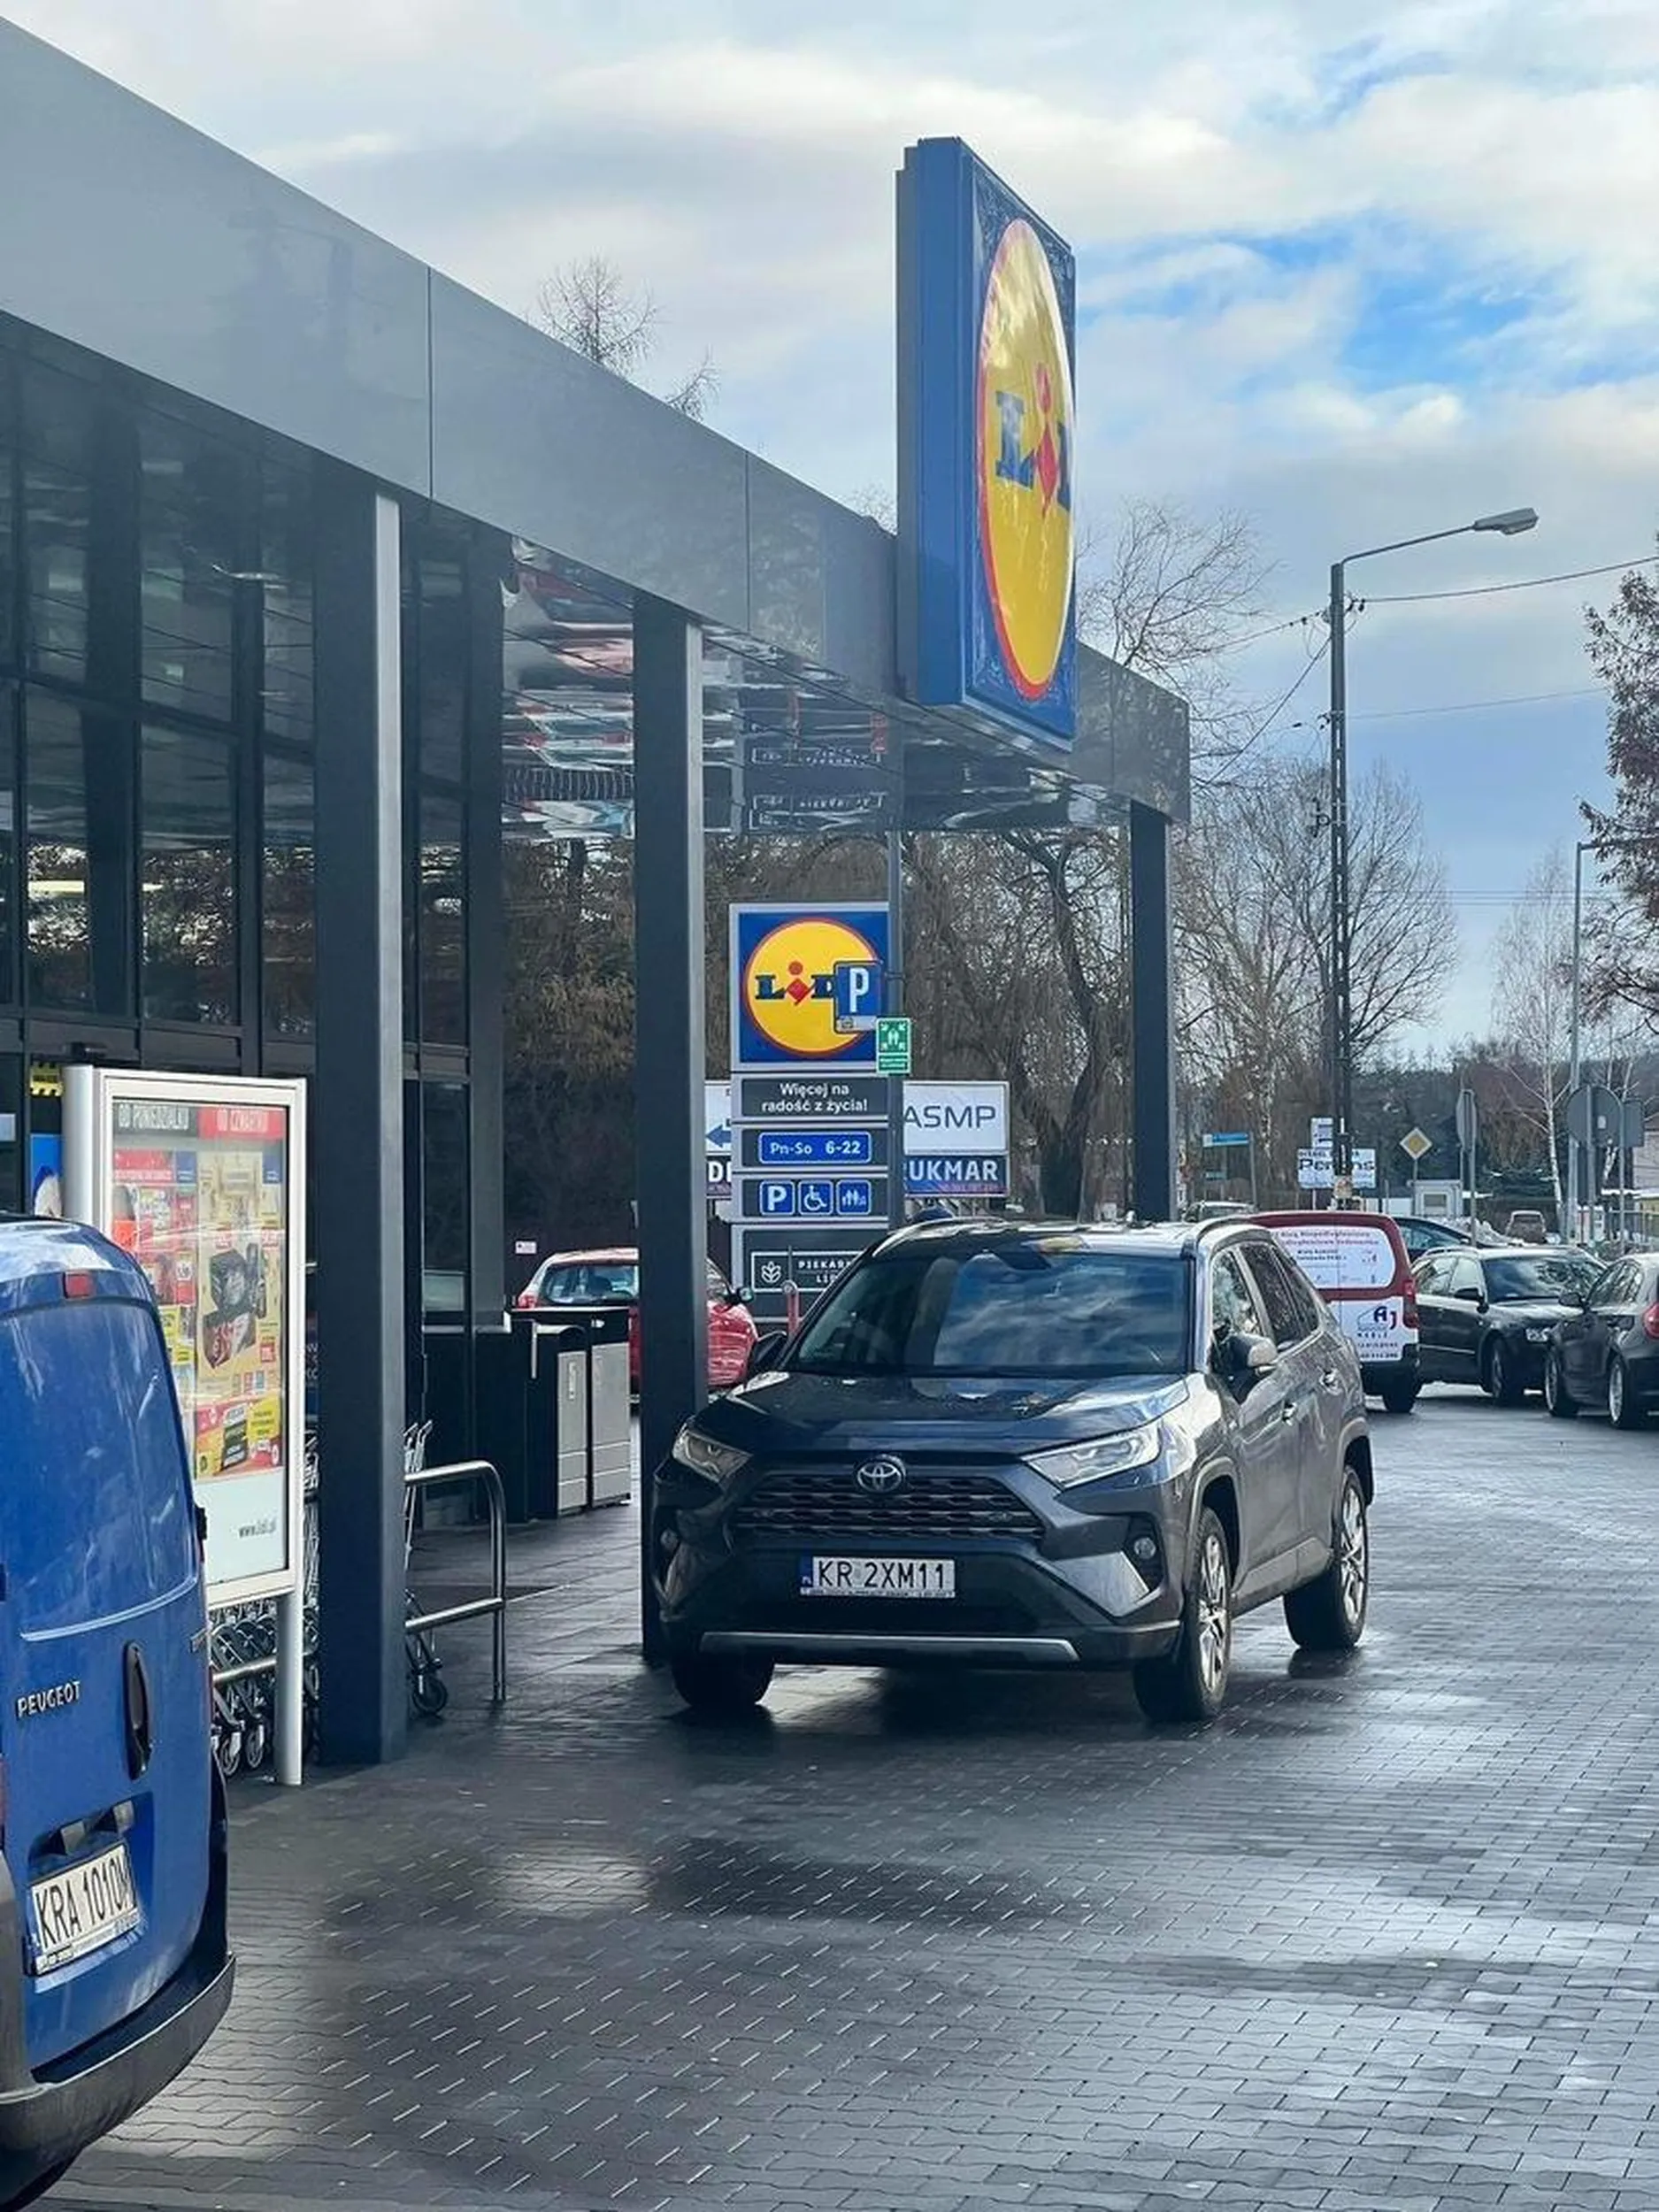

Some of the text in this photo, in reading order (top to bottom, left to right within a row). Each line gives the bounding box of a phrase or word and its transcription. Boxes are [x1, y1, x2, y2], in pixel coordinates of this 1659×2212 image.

[849, 967, 870, 1013] P
[780, 1083, 849, 1098] Więcej na
[762, 1099, 868, 1115] radość z życia!
[771, 1141, 861, 1155] Pn-So 6-22
[709, 1160, 998, 1183] D UKMAR
[767, 1185, 787, 1211] P
[818, 1560, 943, 1589] KR 2XM11
[17, 1680, 81, 1718] PEUGEOT
[35, 1878, 82, 1948] KRA
